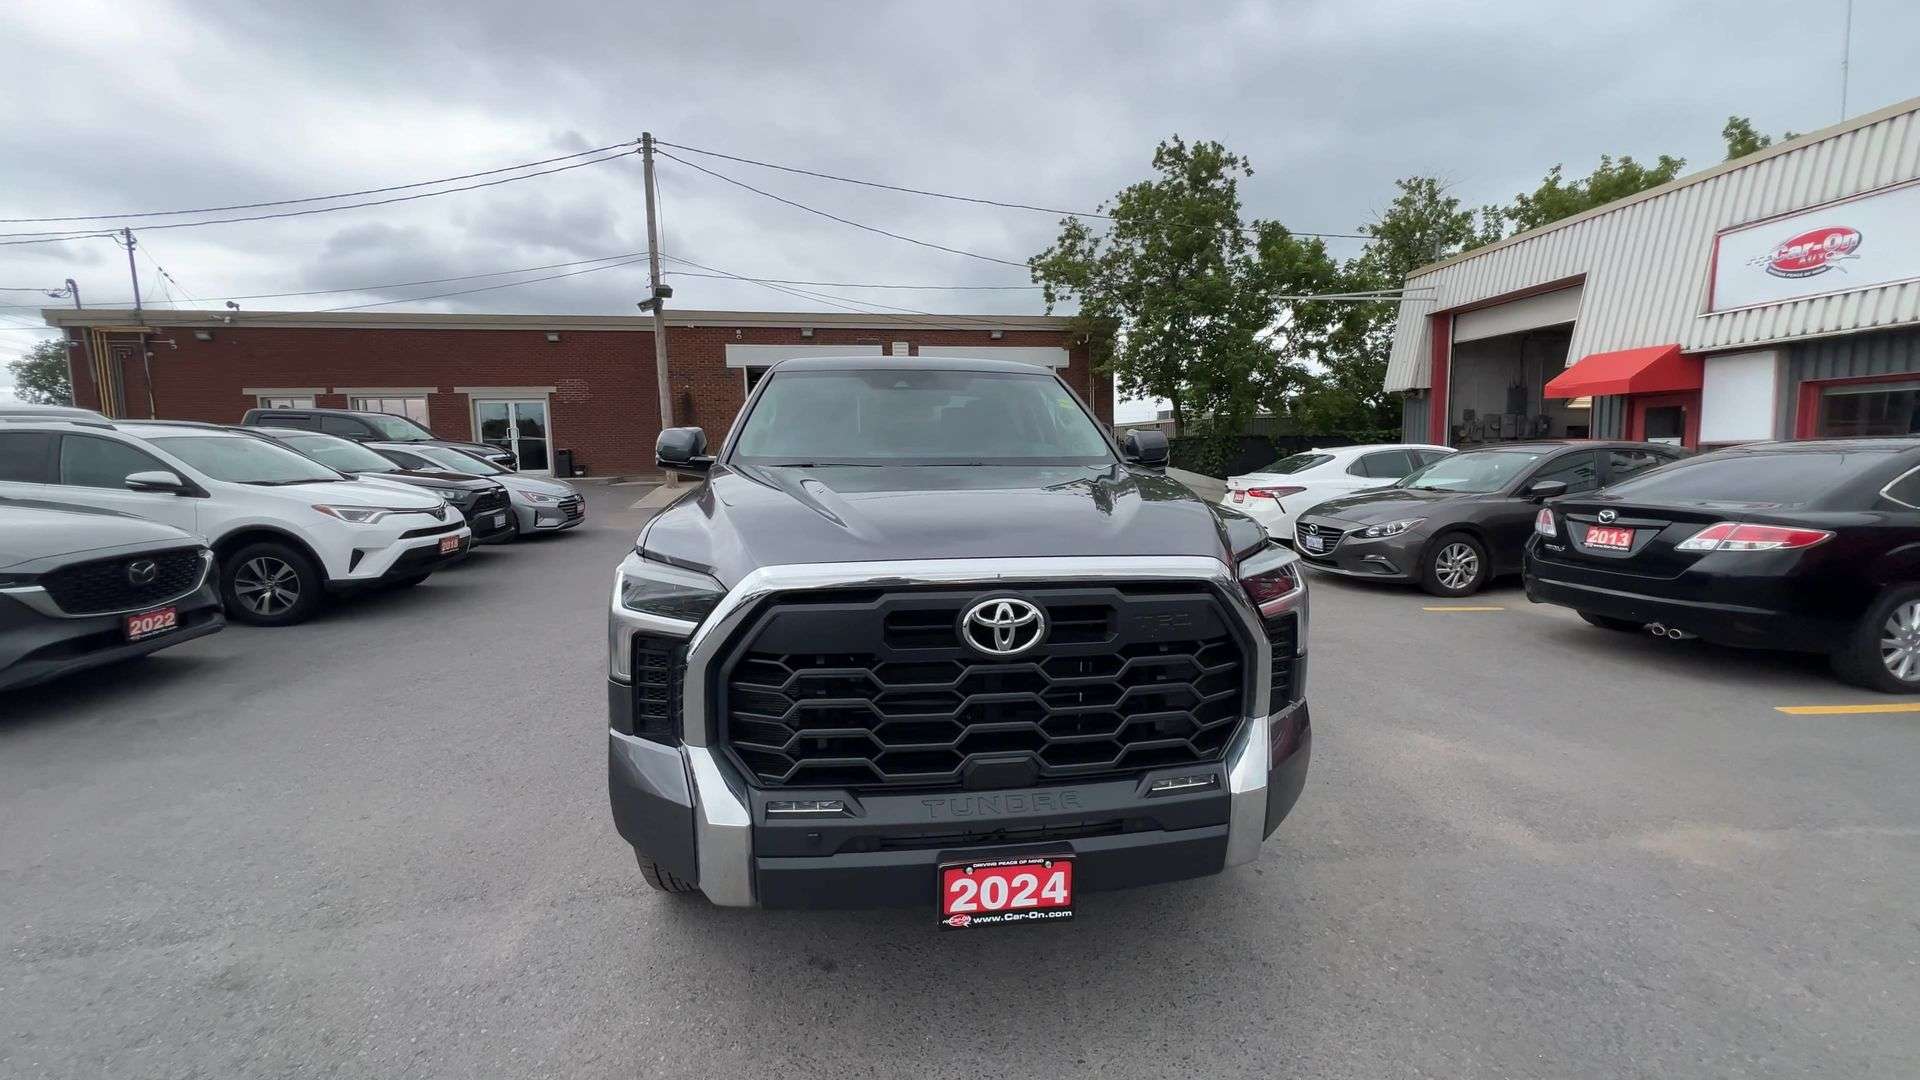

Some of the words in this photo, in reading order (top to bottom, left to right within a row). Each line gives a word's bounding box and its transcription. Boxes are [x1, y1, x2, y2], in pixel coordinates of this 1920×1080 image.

[1777, 232, 1858, 258] Car-On
[1586, 530, 1629, 547] 2013
[130, 612, 175, 636] 2022
[921, 791, 1082, 818] TUNDRA
[949, 871, 1068, 912] 2024
[973, 911, 1072, 924] www.Car-On.com
